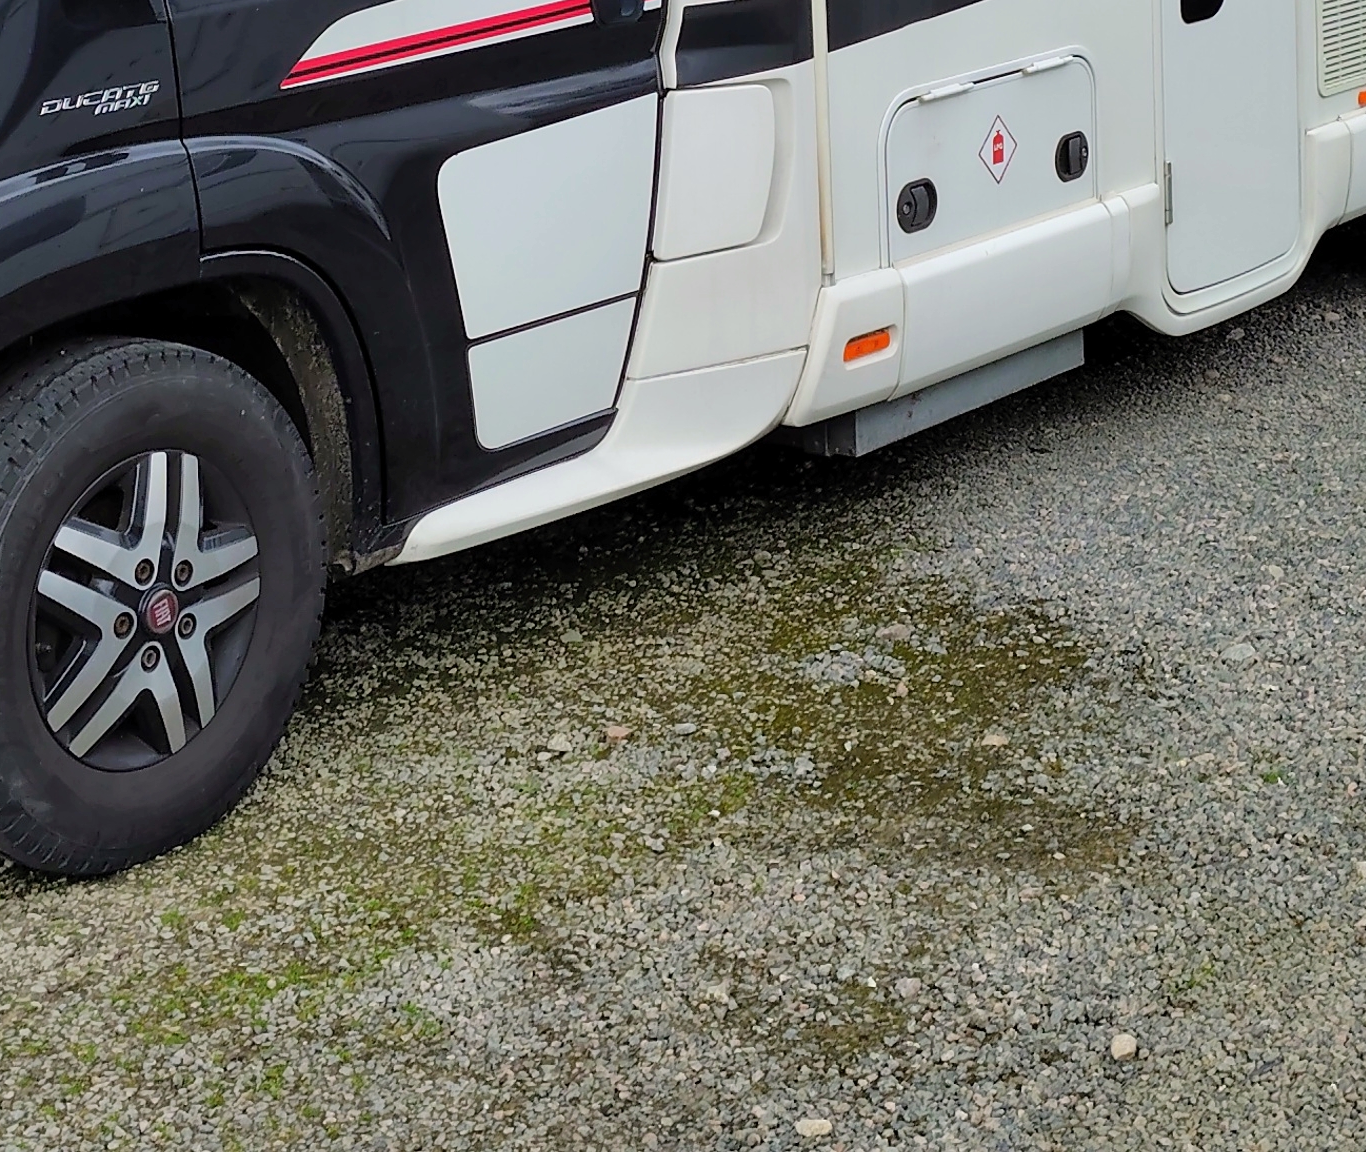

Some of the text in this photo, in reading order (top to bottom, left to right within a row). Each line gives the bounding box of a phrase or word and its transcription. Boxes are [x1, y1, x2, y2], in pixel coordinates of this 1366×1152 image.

[39, 80, 160, 116] DUCATO
[94, 94, 151, 116] MAXI
[152, 598, 172, 626] FIAT
